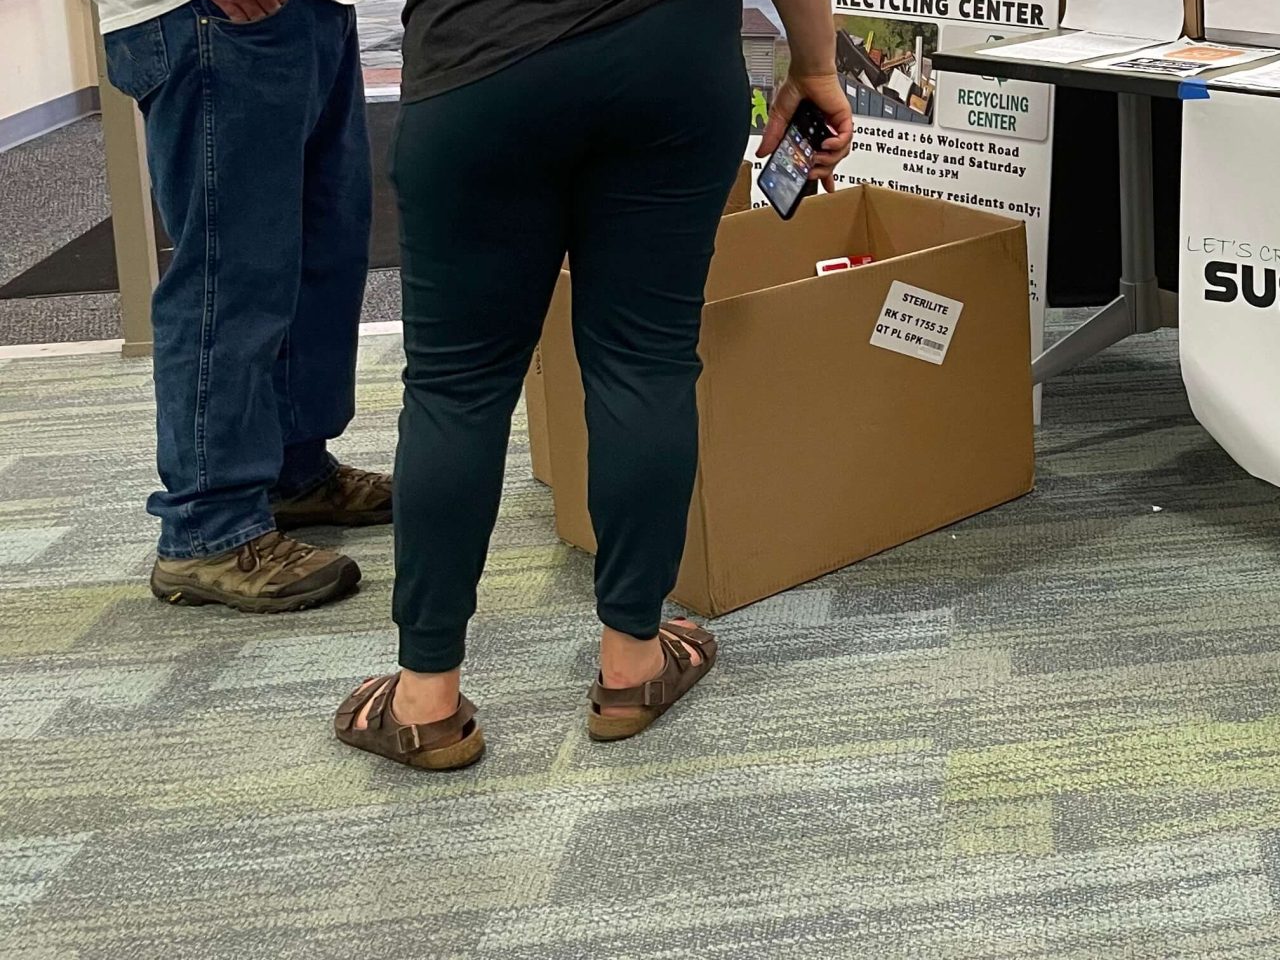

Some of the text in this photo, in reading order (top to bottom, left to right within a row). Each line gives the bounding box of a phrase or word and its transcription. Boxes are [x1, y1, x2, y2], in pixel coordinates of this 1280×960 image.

[958, 88, 1029, 113] RECYCLING
[968, 110, 1017, 132] CENTER
[920, 132, 1020, 158] 66 Wolcott Road
[876, 144, 1027, 177] Wednesday and Saturday
[903, 163, 959, 179] 8AM 3PM
[947, 192, 1004, 210] residents
[1186, 235, 1254, 258] LET'S
[902, 292, 949, 316] STERILITE
[884, 308, 949, 336] RK 1755 32
[904, 331, 924, 346] 6PK
